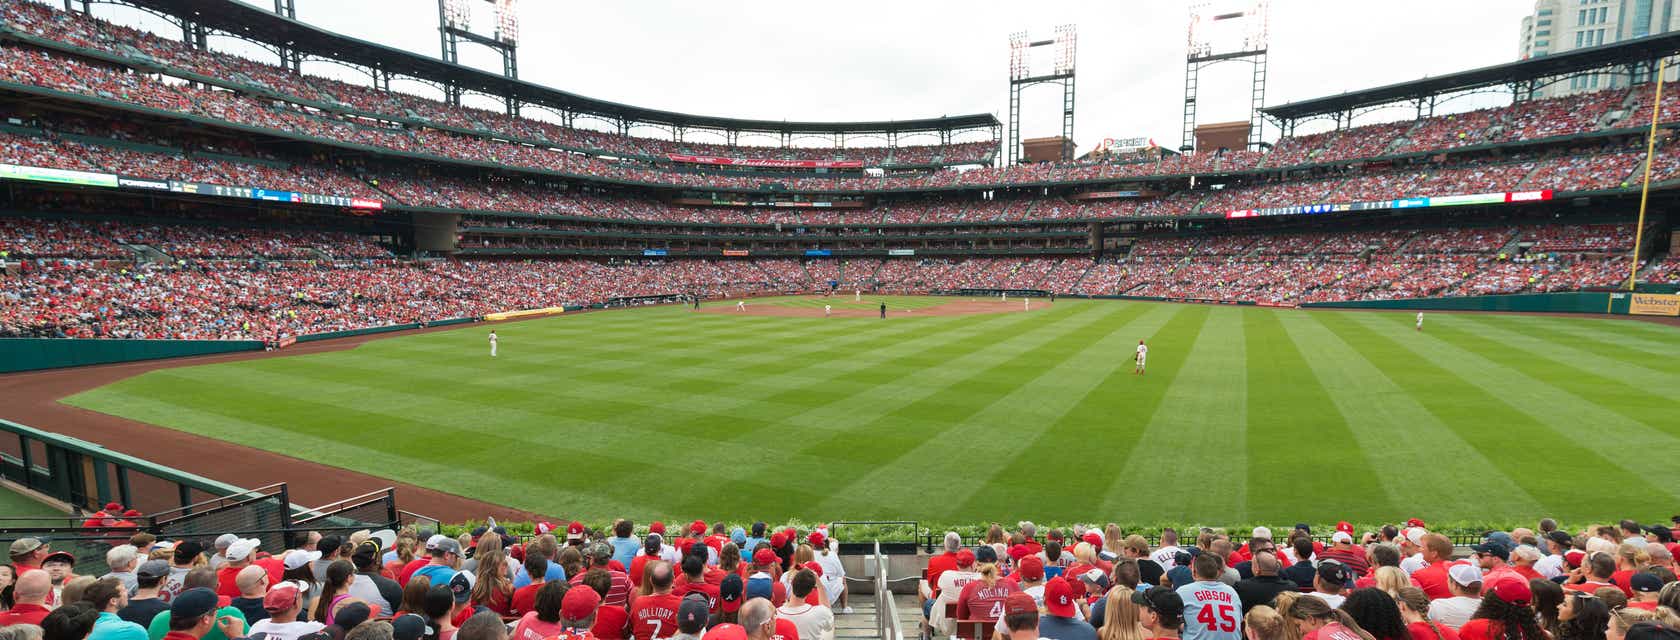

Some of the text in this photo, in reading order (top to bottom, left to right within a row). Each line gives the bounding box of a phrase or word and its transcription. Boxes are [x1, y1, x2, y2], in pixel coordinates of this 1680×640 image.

[732, 157, 804, 167] Budweiser
[1633, 296, 1679, 306] Webster
[977, 587, 1009, 600] MOLINA
[1194, 589, 1232, 604] GIBSON
[638, 607, 674, 620] HOLLIDAY
[989, 600, 1001, 618] 4
[1196, 603, 1237, 633] 45
[646, 619, 663, 640] 7
